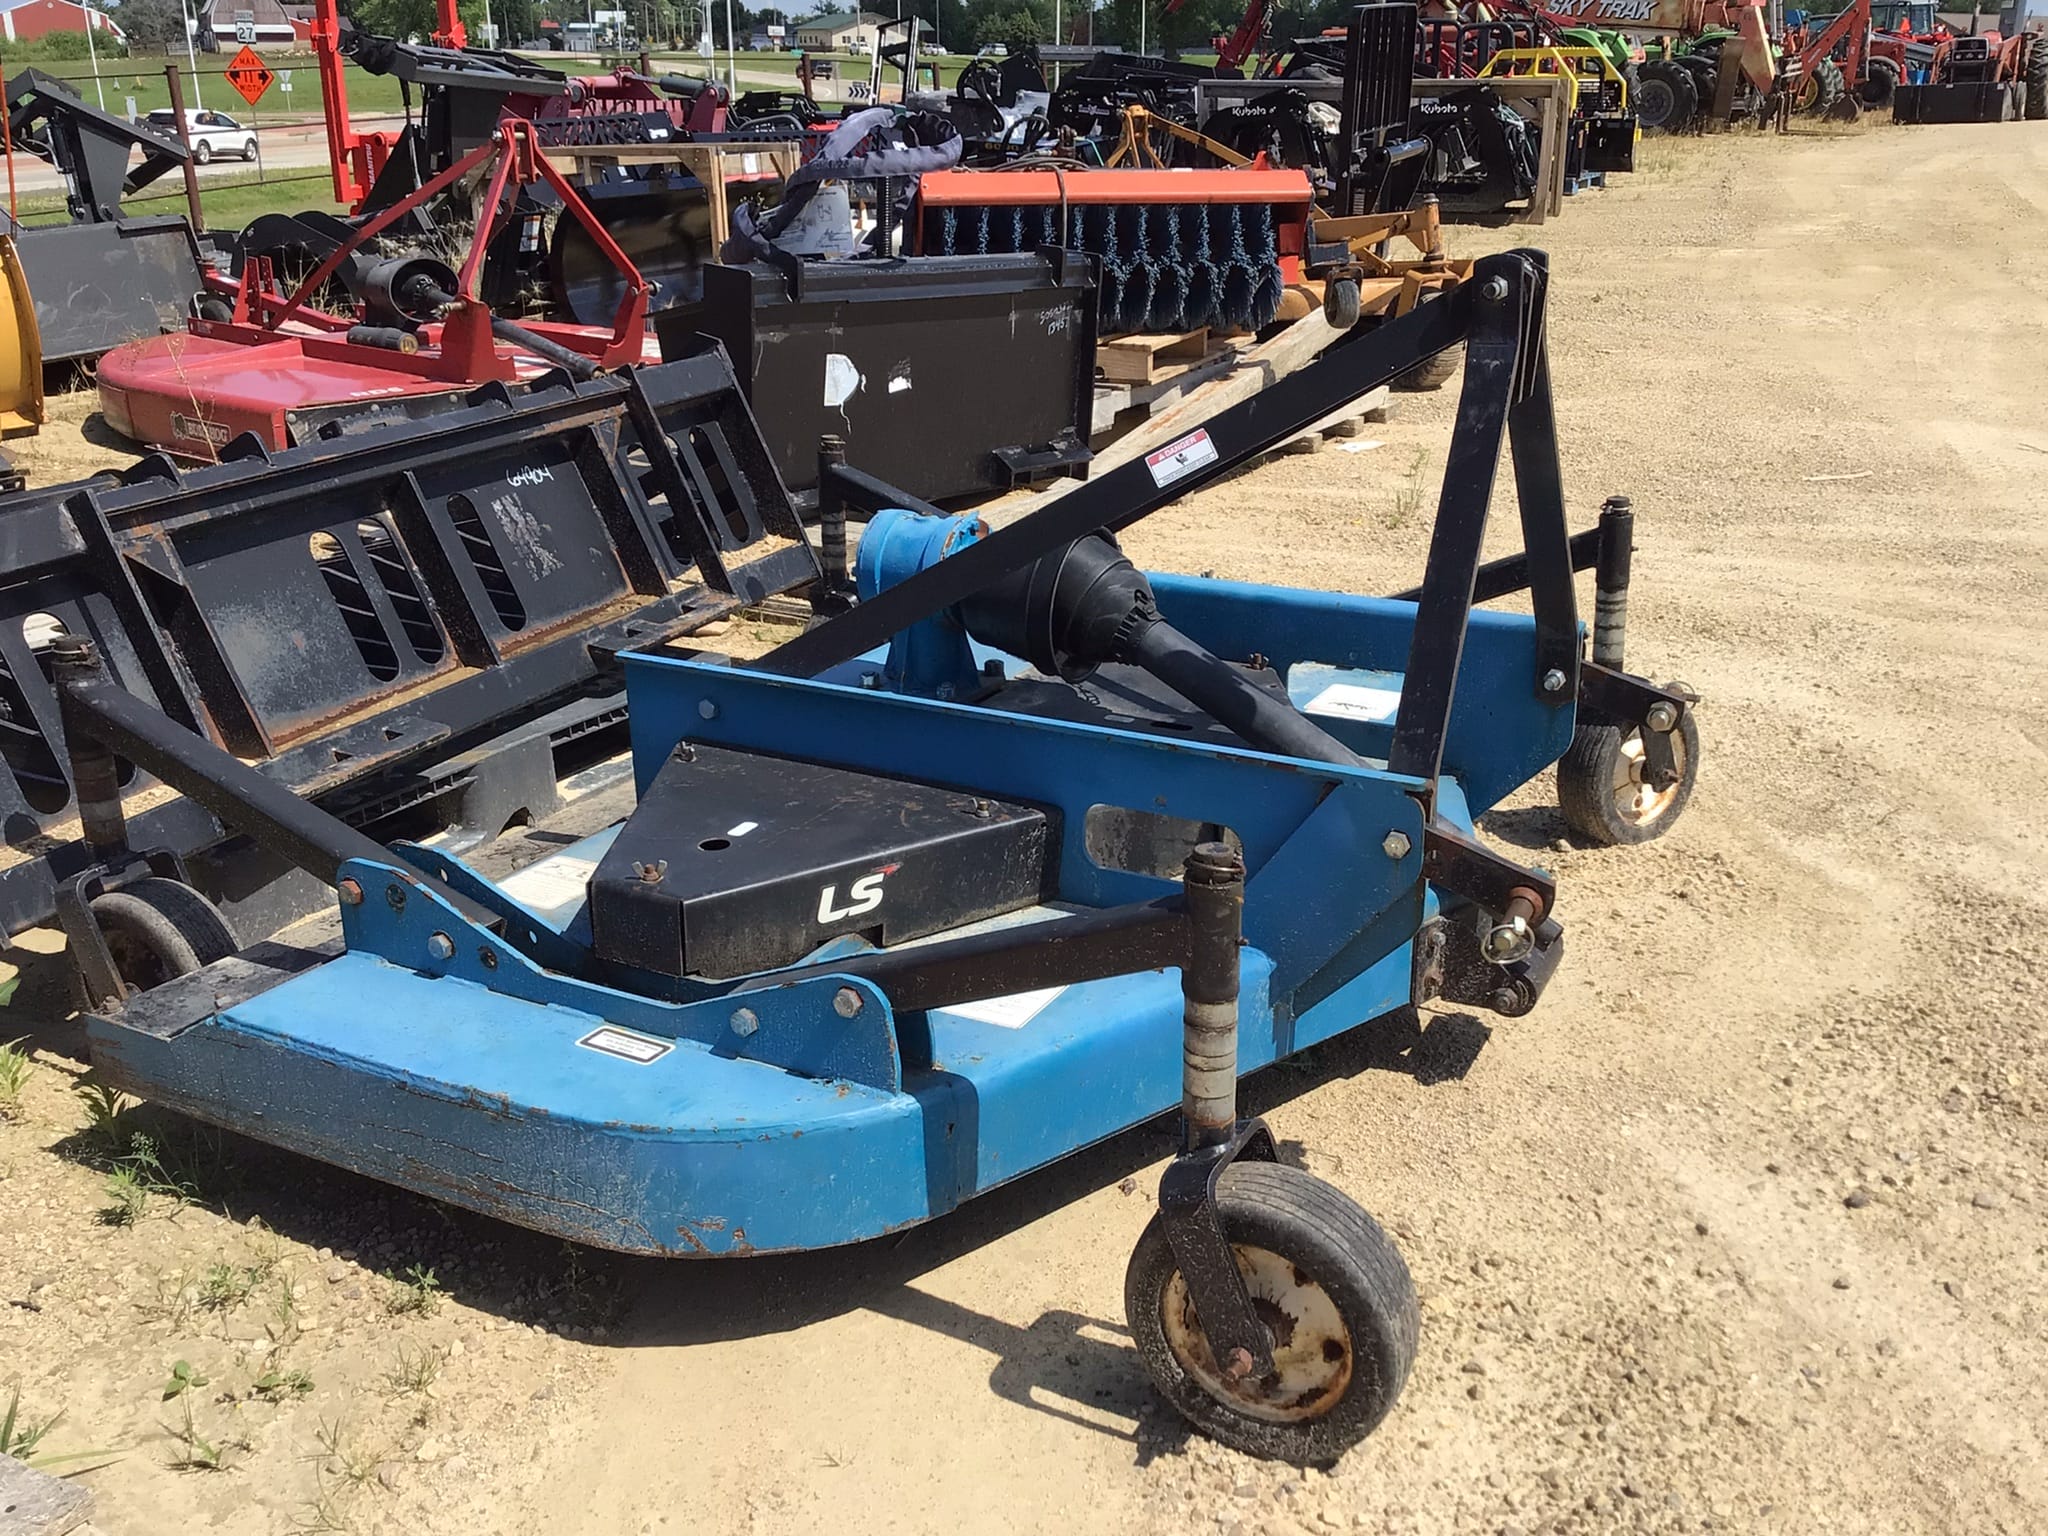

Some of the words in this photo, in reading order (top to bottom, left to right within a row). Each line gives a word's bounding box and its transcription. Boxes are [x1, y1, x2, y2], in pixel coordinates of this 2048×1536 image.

[1546, 0, 1593, 16] SKY
[1596, 0, 1660, 20] TRAK
[238, 27, 253, 39] 27
[240, 84, 262, 93] WIDTH
[1232, 105, 1266, 116] Kubota
[1420, 103, 1458, 114] Kubota
[364, 142, 376, 185] MANITOU
[1164, 436, 1197, 457] DANGER
[817, 872, 885, 924] LS
